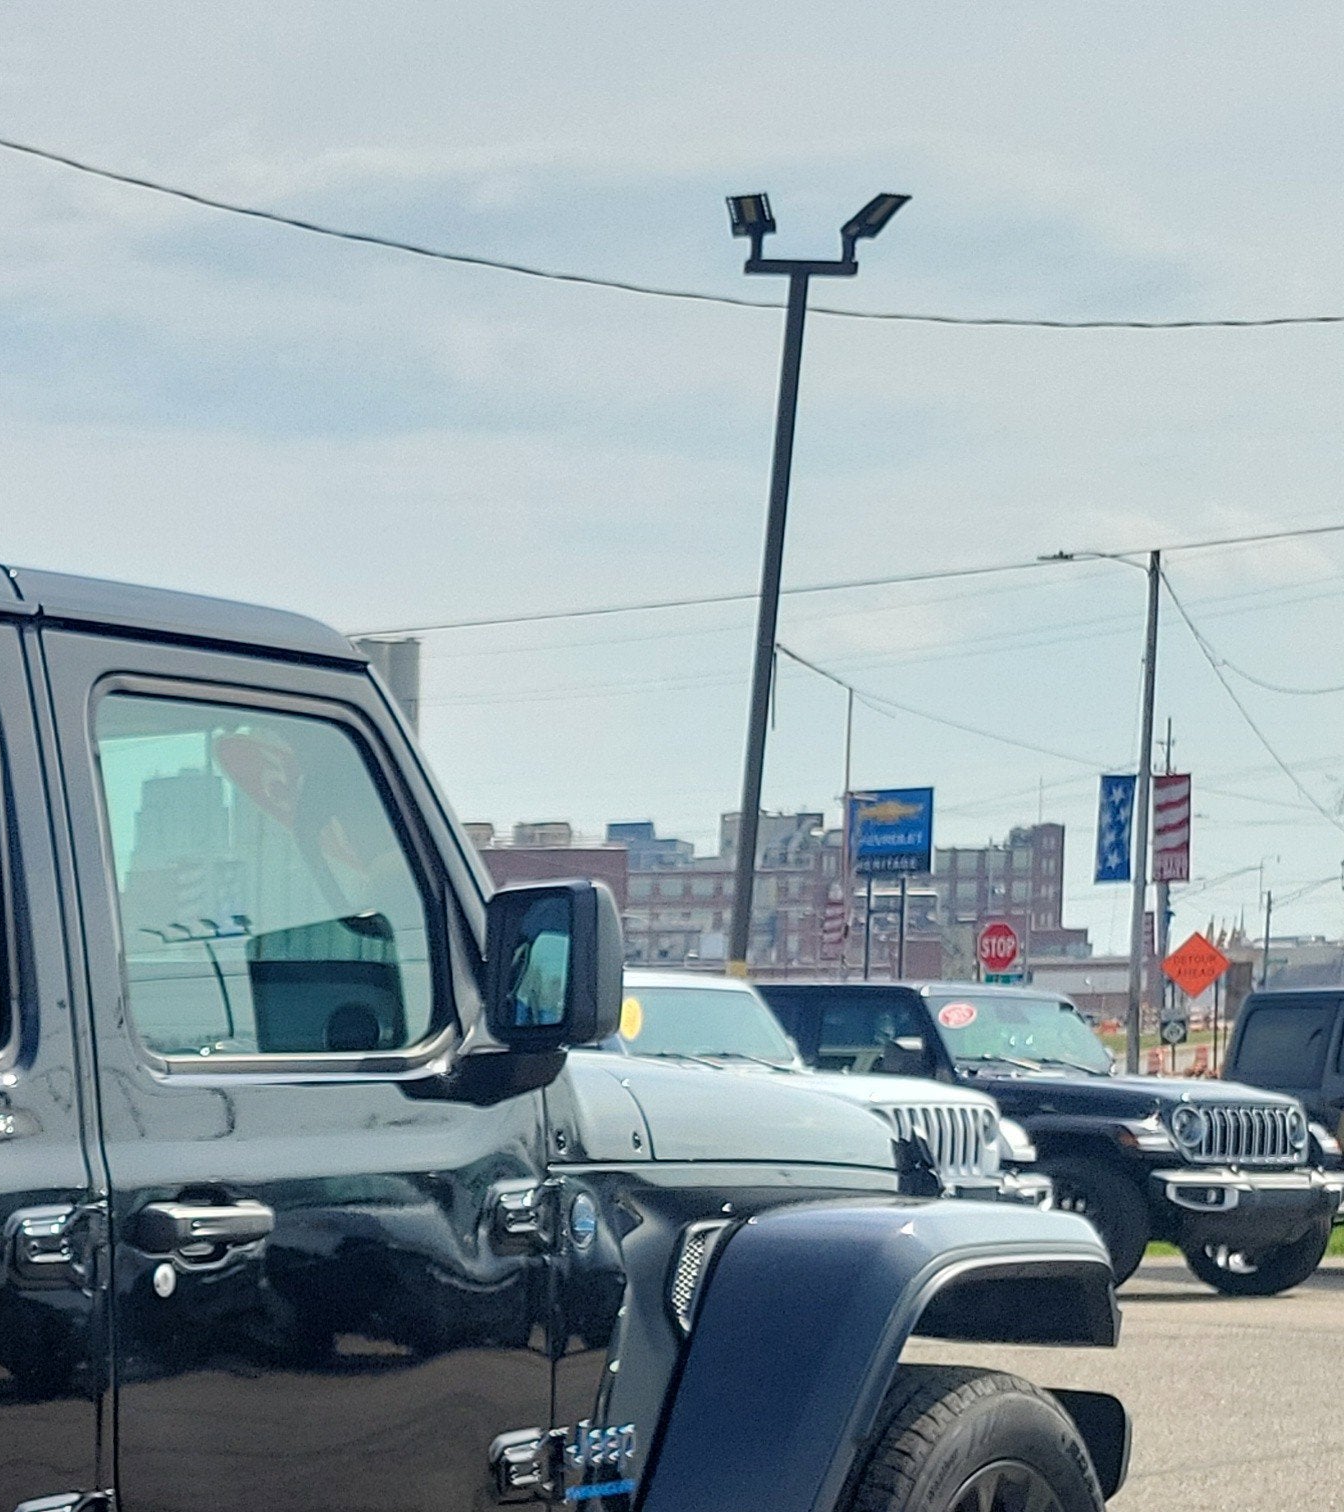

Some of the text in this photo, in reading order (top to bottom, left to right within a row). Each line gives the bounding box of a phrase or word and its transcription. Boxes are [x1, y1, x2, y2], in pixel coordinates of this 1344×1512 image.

[859, 831, 923, 846] HEVROLET
[981, 934, 1015, 959] STOP
[1173, 954, 1217, 965] DETOUR
[1176, 968, 1215, 978] AHEAD
